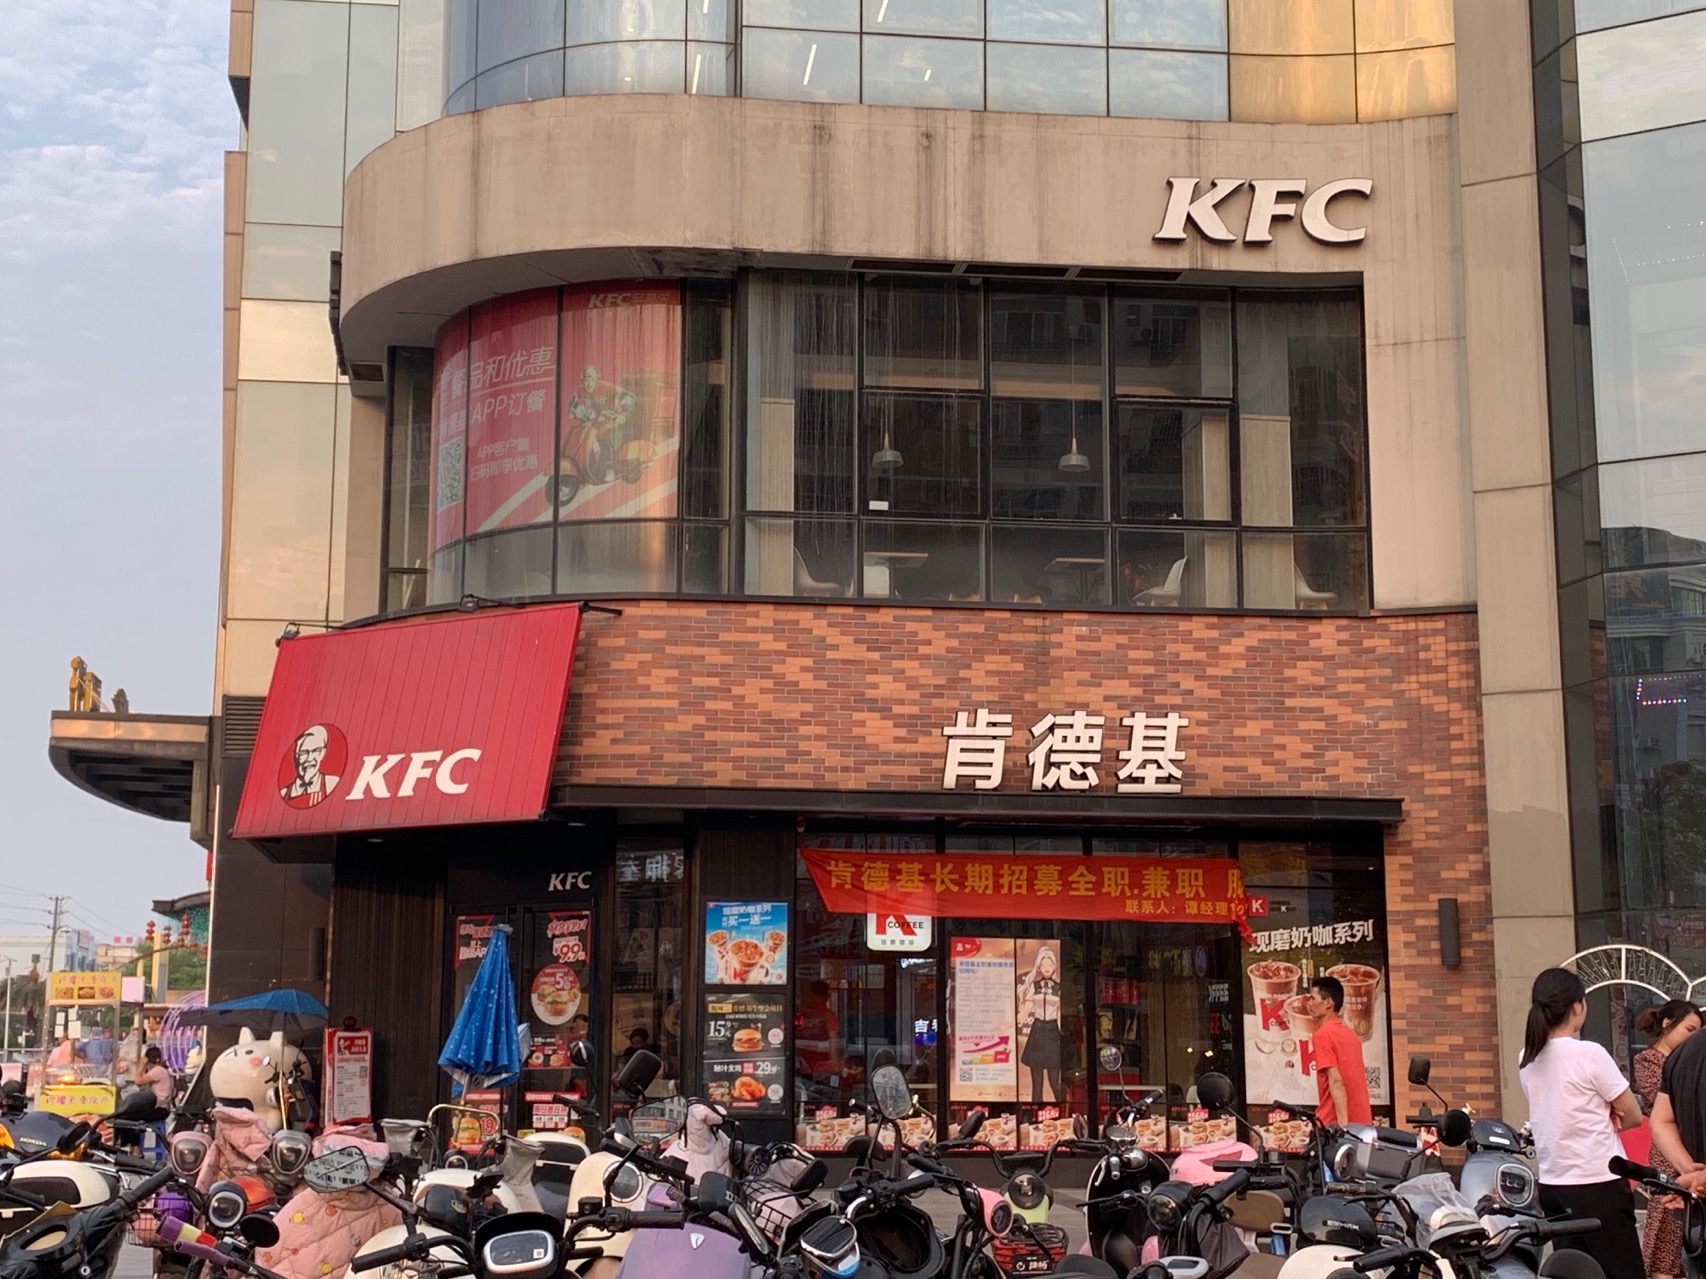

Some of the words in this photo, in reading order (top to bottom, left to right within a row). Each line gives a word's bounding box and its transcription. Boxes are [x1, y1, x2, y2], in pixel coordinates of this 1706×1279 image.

[1153, 176, 1373, 244] KFC
[587, 292, 631, 308] KFC
[942, 708, 1189, 793] 肯德基
[345, 748, 482, 800] KFC
[548, 871, 592, 891] KFC
[1251, 899, 1265, 913] K
[728, 914, 772, 927] 买一送一
[887, 921, 924, 929] COFFEE
[1249, 919, 1374, 953] 现磨奶咖系列
